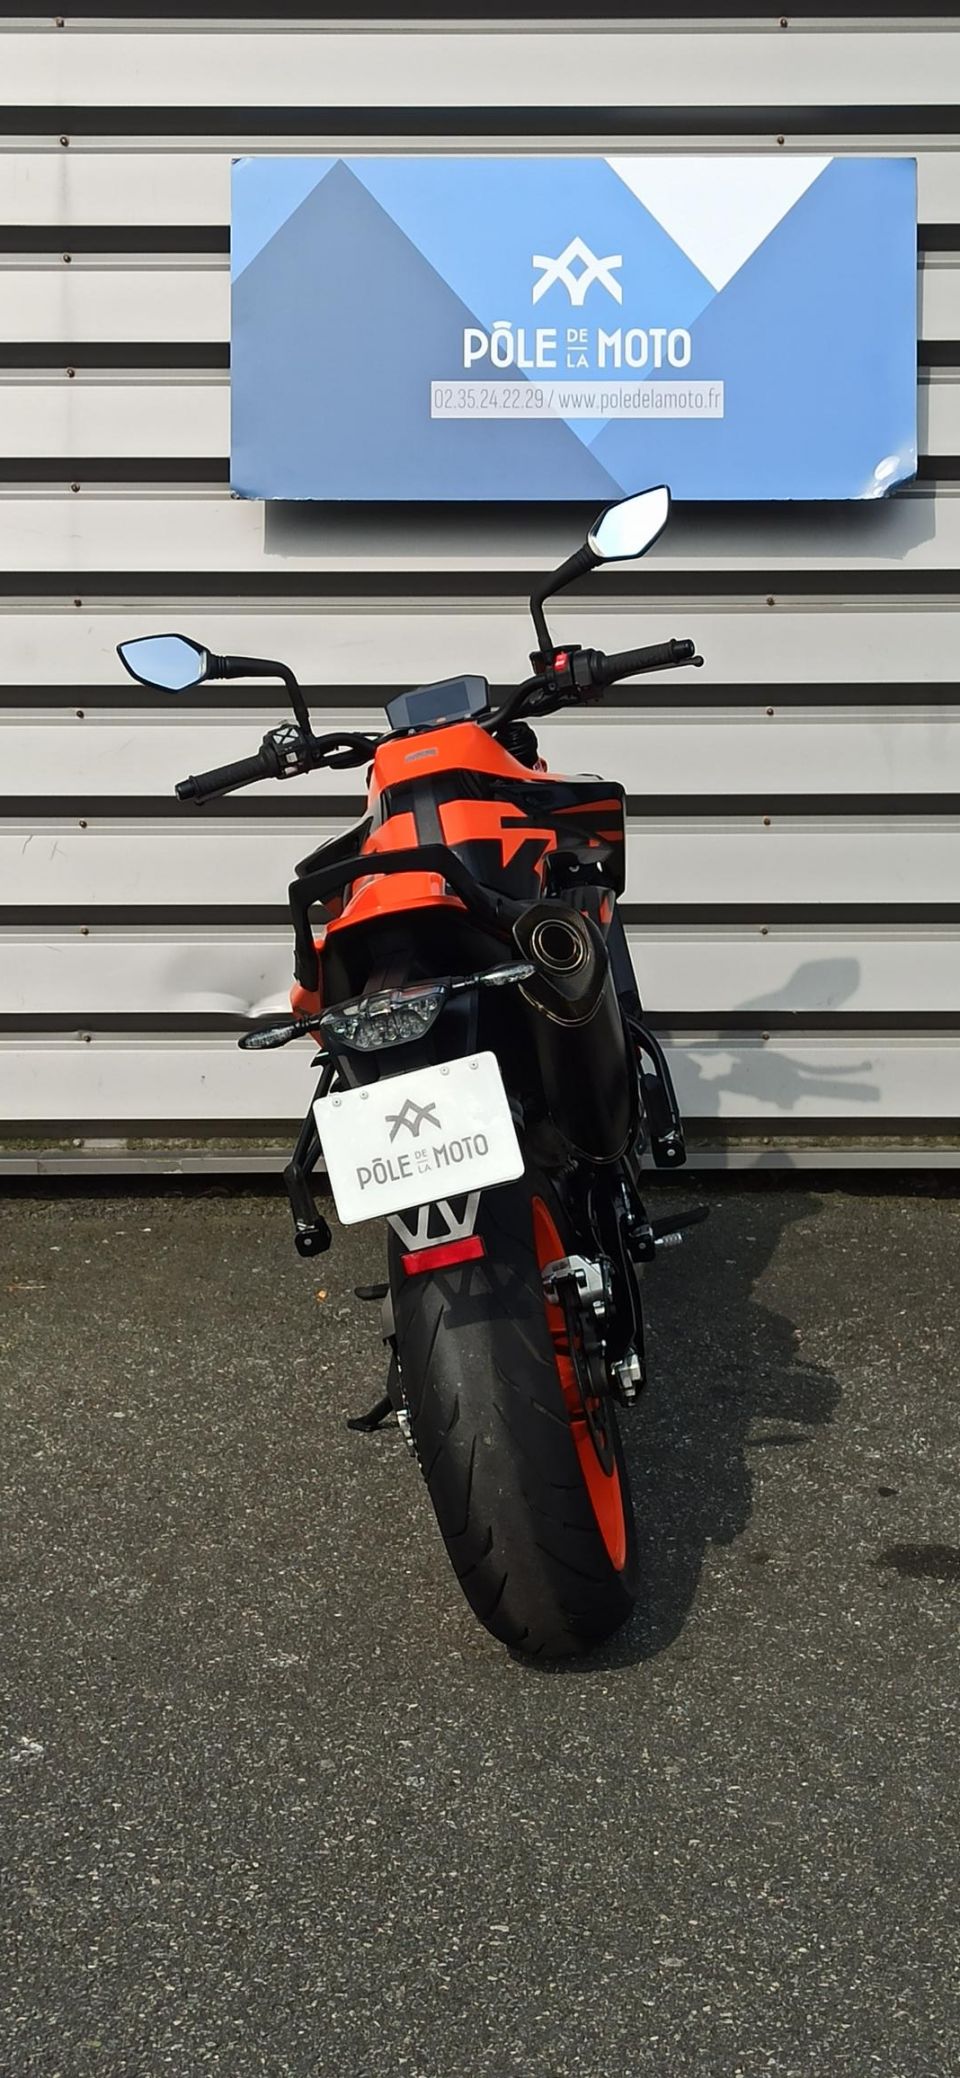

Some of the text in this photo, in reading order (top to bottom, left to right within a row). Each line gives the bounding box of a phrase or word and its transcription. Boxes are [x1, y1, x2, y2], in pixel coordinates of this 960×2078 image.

[463, 320, 692, 368] PÔLE DE LA MOTO
[434, 388, 544, 409] 02.35.24.22.29
[558, 387, 721, 414] www.poledelamoto.fr
[414, 1148, 428, 1160] DE
[432, 1133, 489, 1168] MOTO
[418, 1163, 432, 1174] LA
